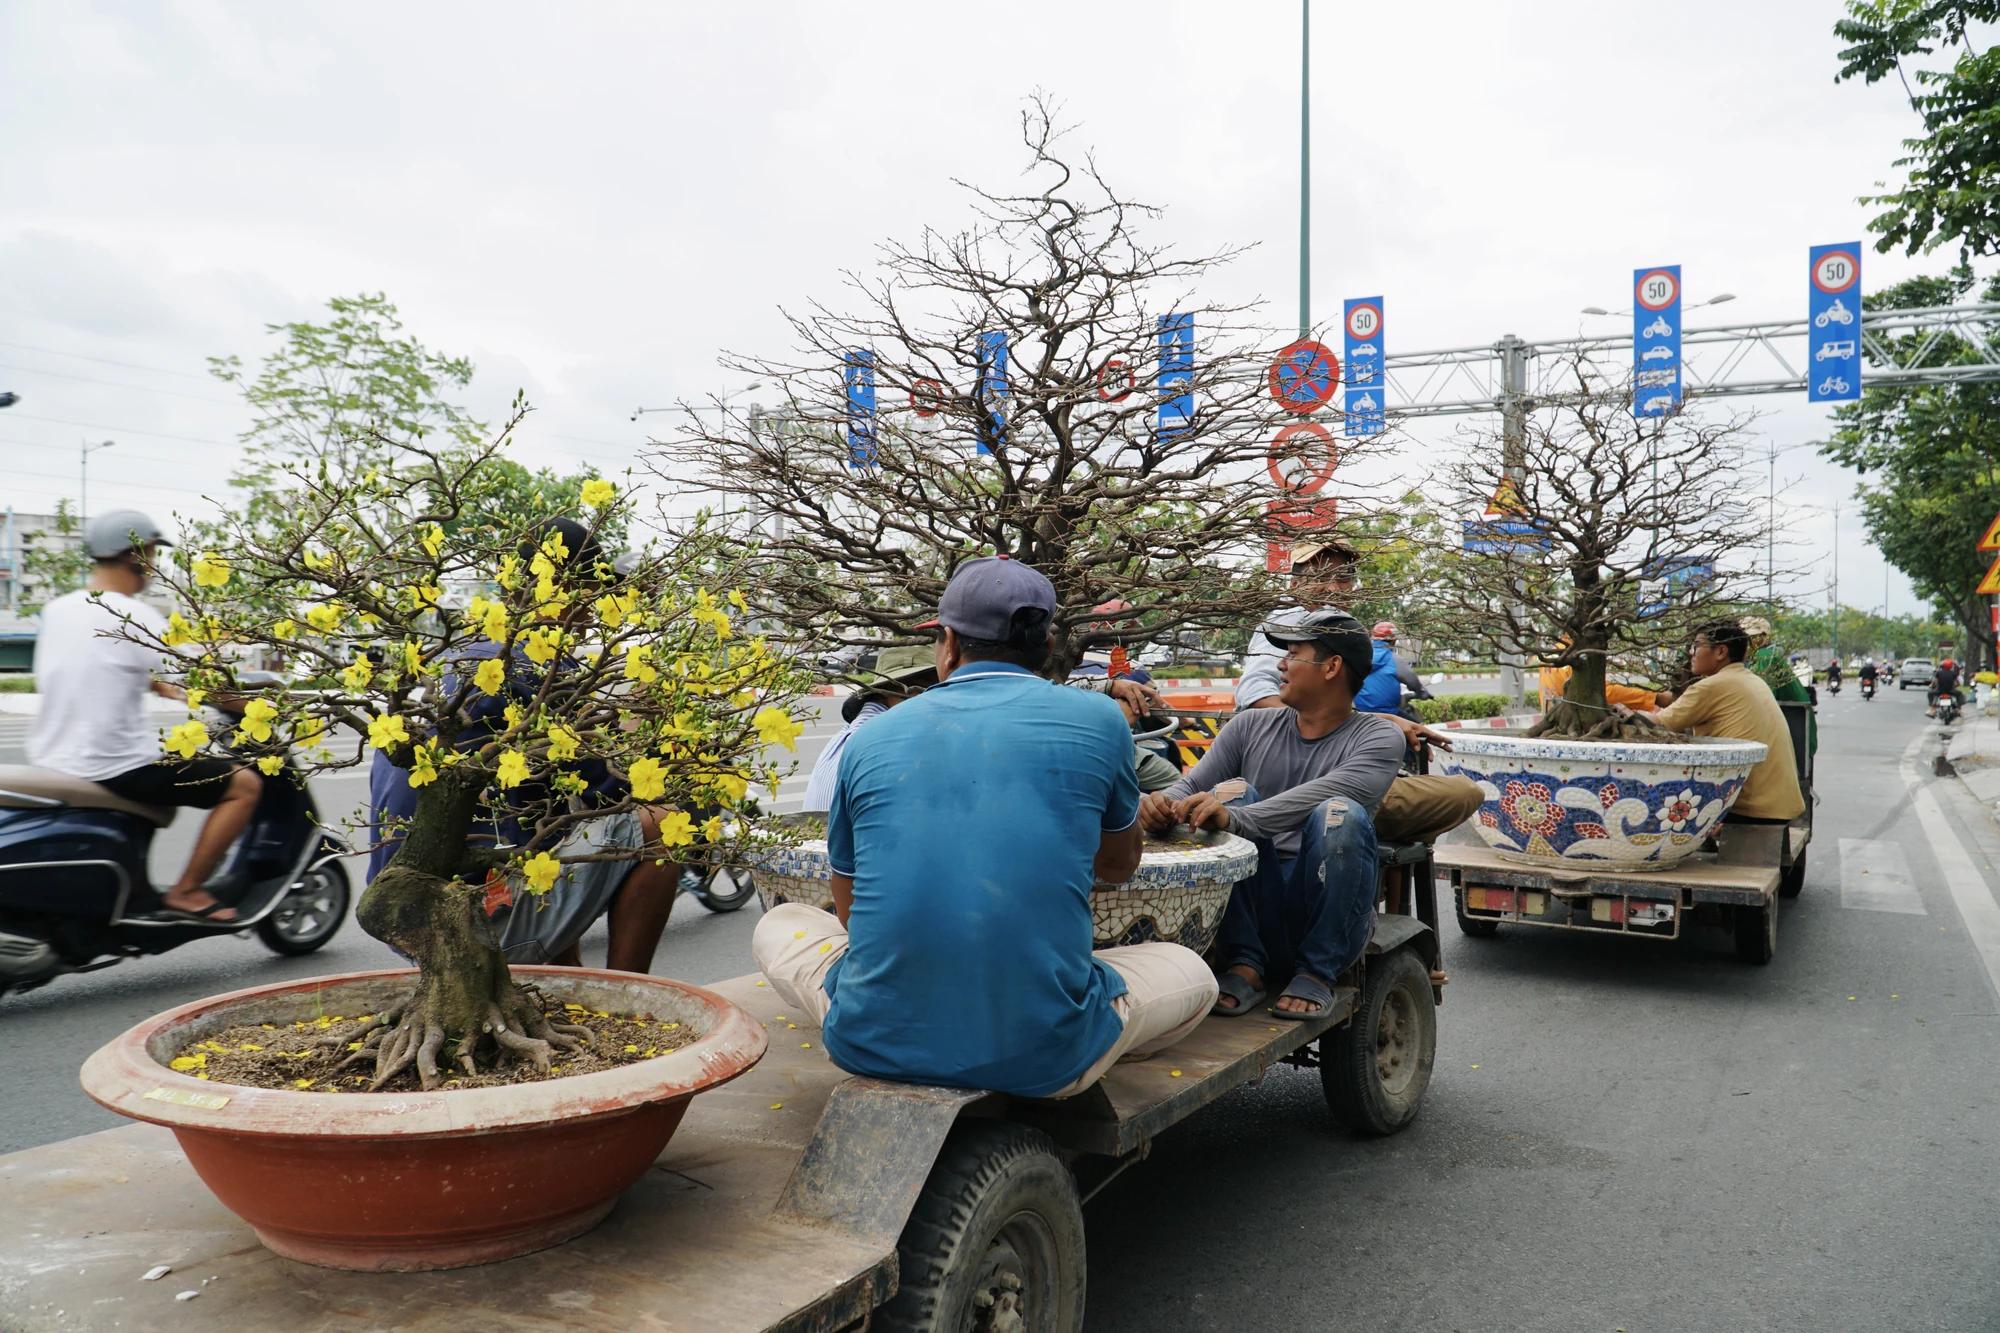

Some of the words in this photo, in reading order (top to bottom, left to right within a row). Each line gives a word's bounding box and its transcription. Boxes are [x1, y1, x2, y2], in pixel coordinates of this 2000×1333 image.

[1826, 262, 1845, 281] 50
[1649, 281, 1666, 299] 50
[1357, 313, 1371, 329] 50
